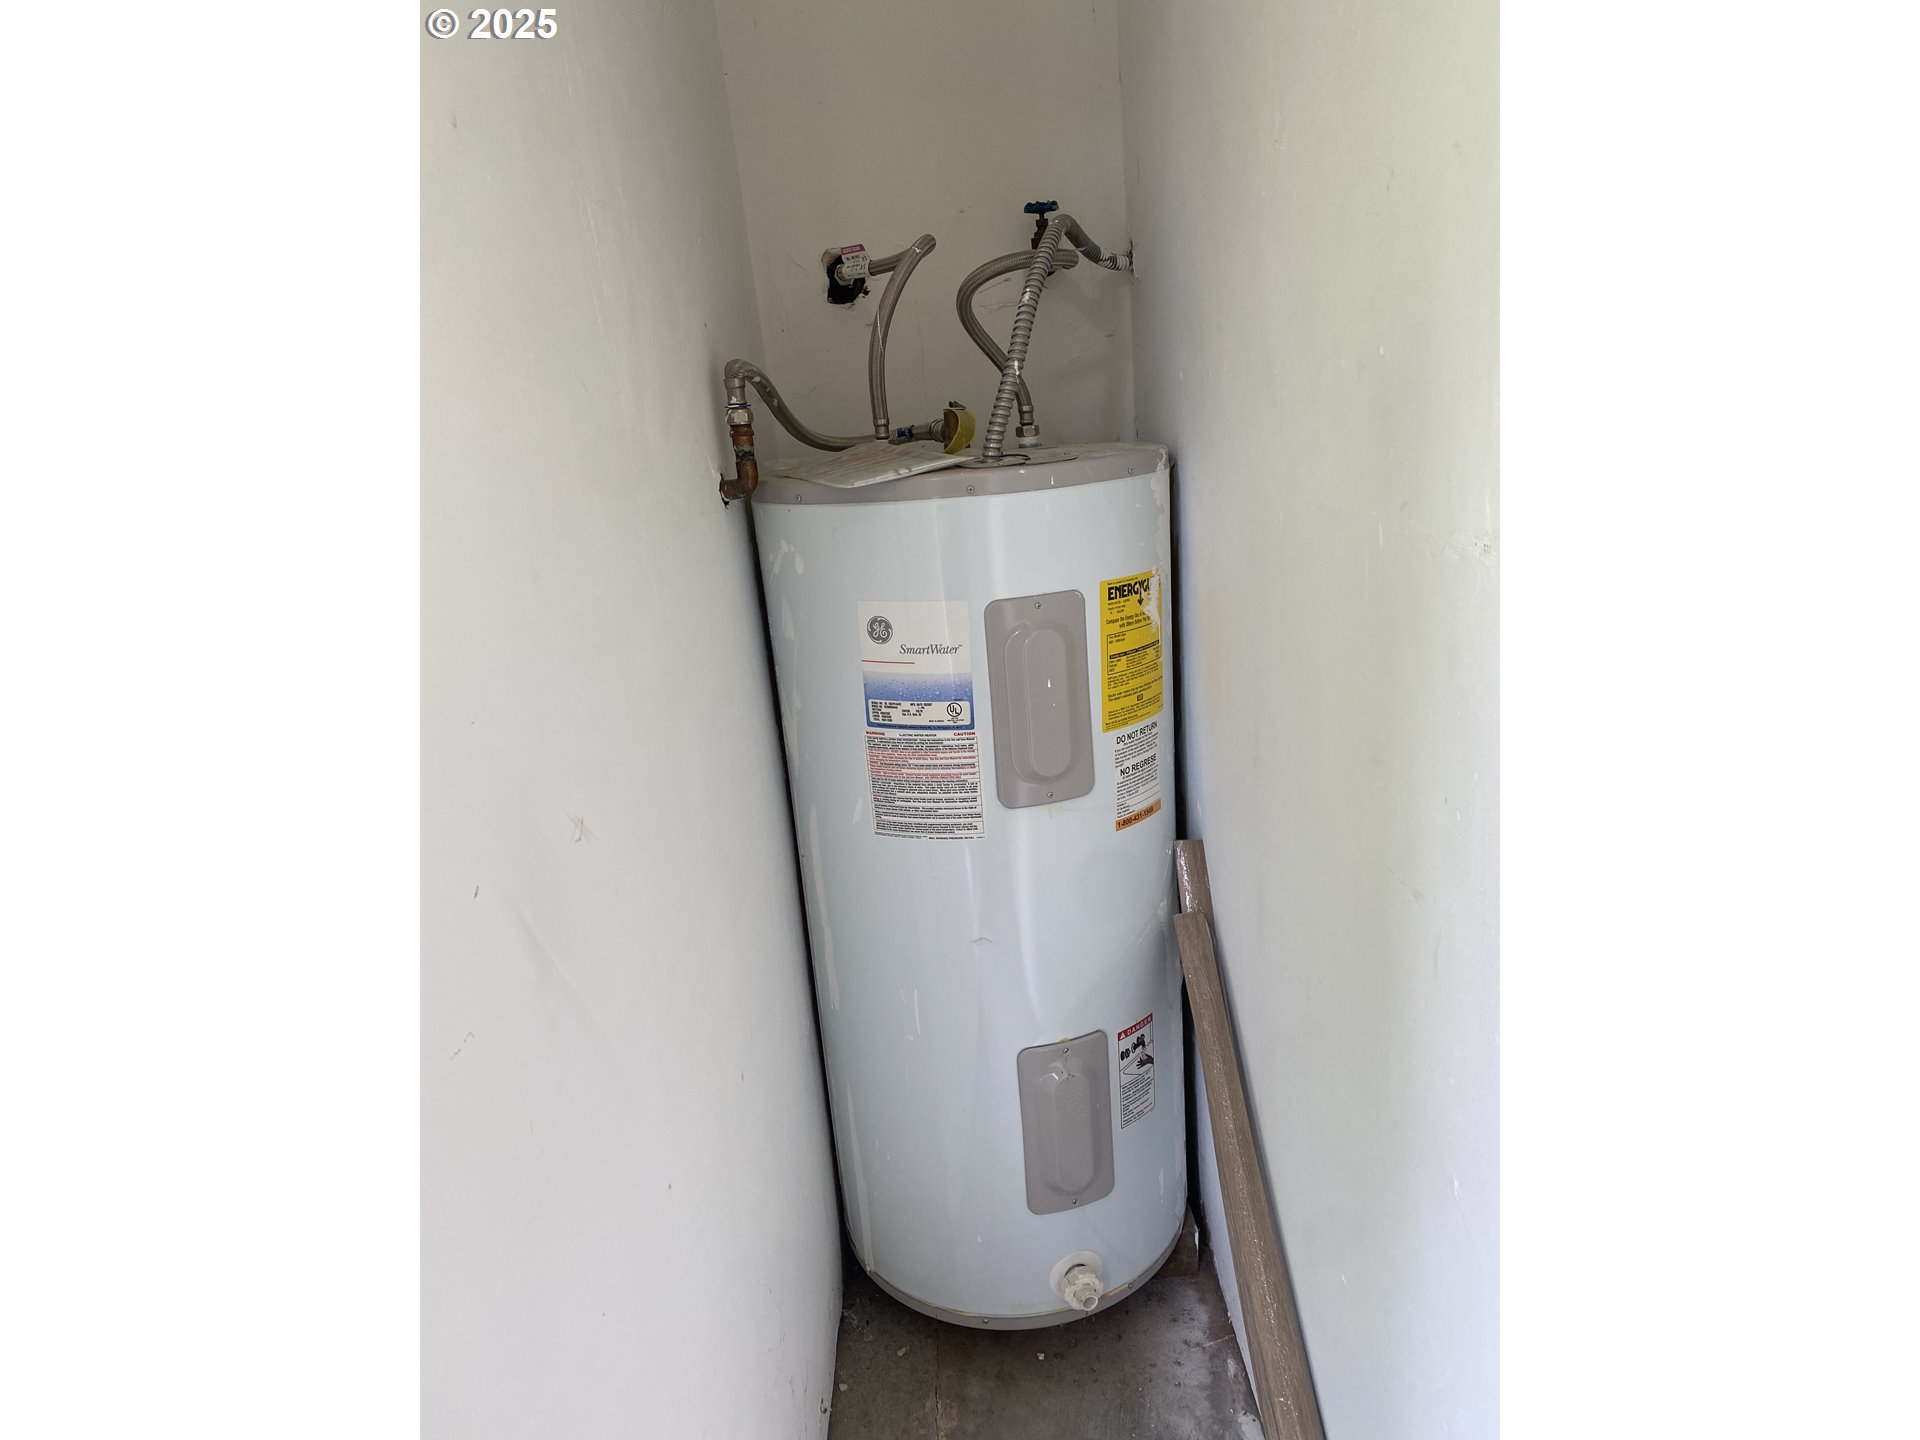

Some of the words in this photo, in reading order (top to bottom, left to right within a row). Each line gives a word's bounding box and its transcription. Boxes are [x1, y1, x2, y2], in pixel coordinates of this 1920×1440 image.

[1117, 735, 1126, 744] DO
[1127, 729, 1138, 740] NOT
[1140, 721, 1158, 735] RETURN
[1120, 766, 1130, 776] NO
[1132, 753, 1157, 772] REGRESE
[1127, 1016, 1152, 1035] DANGER
